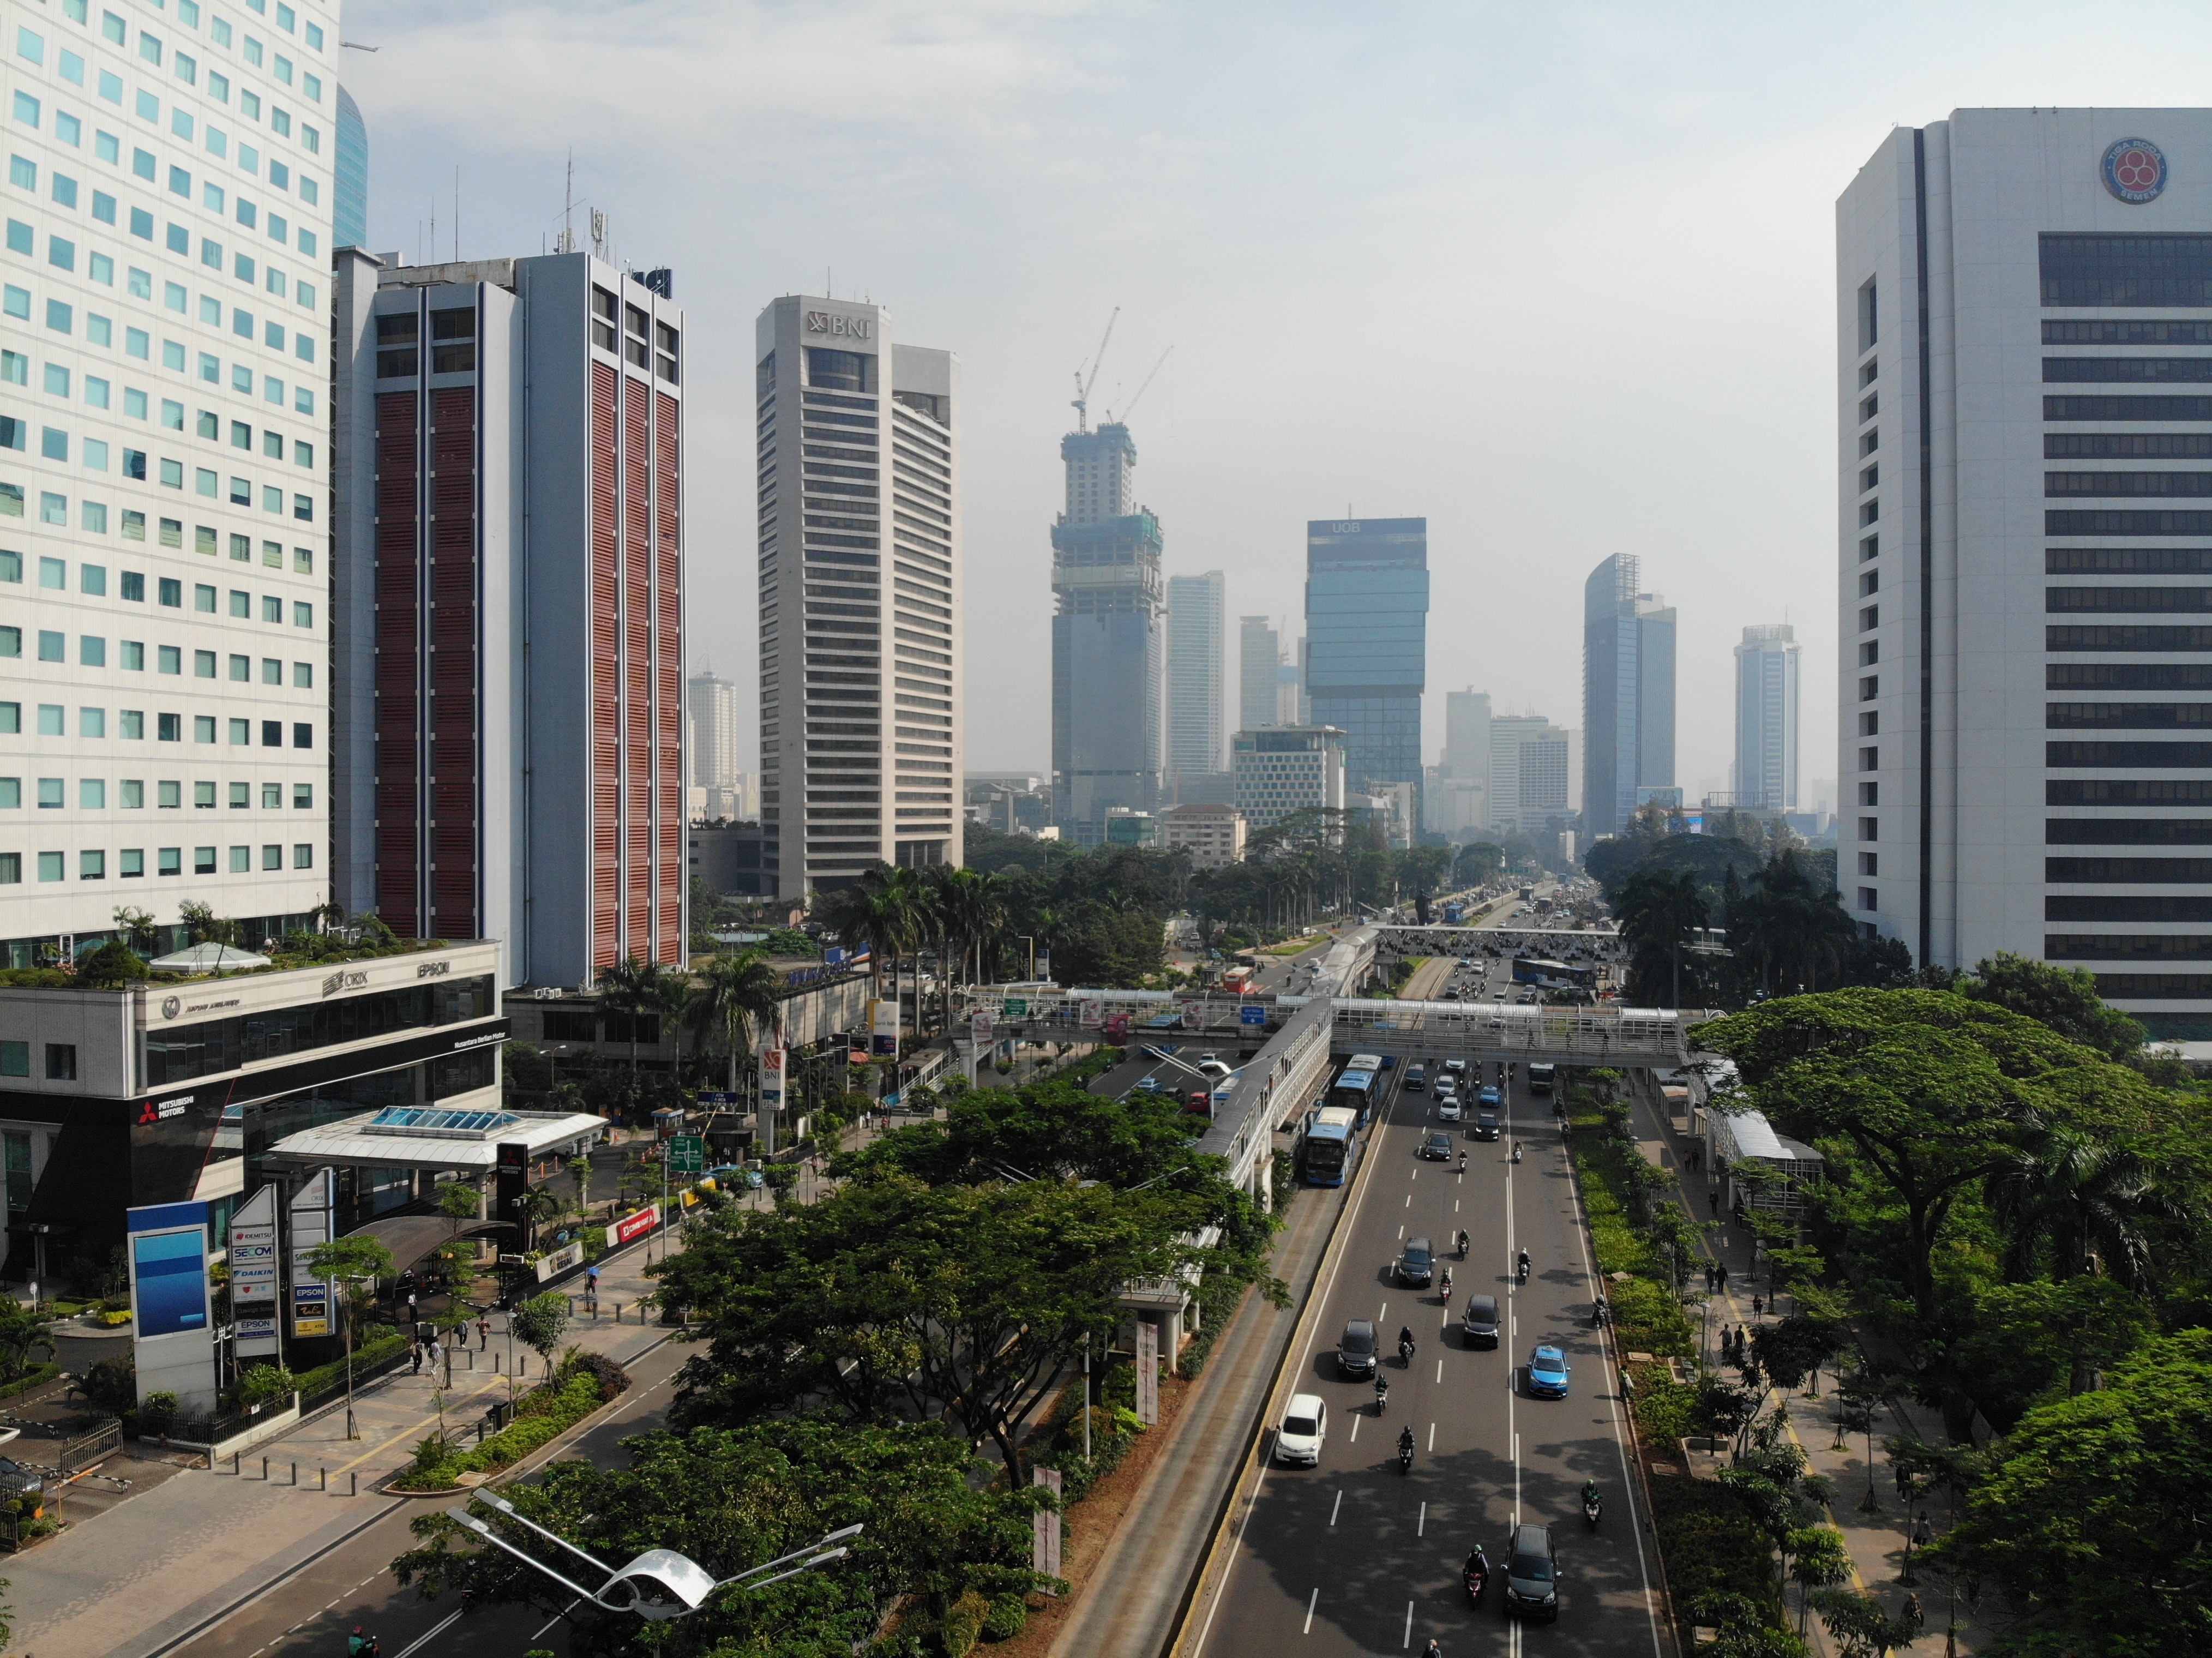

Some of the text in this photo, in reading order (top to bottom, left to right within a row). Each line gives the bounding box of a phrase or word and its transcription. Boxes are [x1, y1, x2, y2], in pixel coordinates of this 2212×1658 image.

[2108, 141, 2161, 160] TIGA RODA
[2120, 188, 2158, 200] SEMEN
[832, 316, 871, 339] BNI
[1333, 522, 1360, 533] UOB
[417, 961, 450, 978] EPSON
[345, 971, 368, 987] ORIX
[492, 1032, 506, 1040] Motor
[764, 1071, 780, 1079] BNI
[159, 1096, 194, 1110] MITSUBISHI
[159, 1106, 185, 1119] MOTORS
[235, 1246, 272, 1258] SECOM
[297, 1288, 323, 1296] EPSON
[241, 1320, 270, 1329] EPSON
